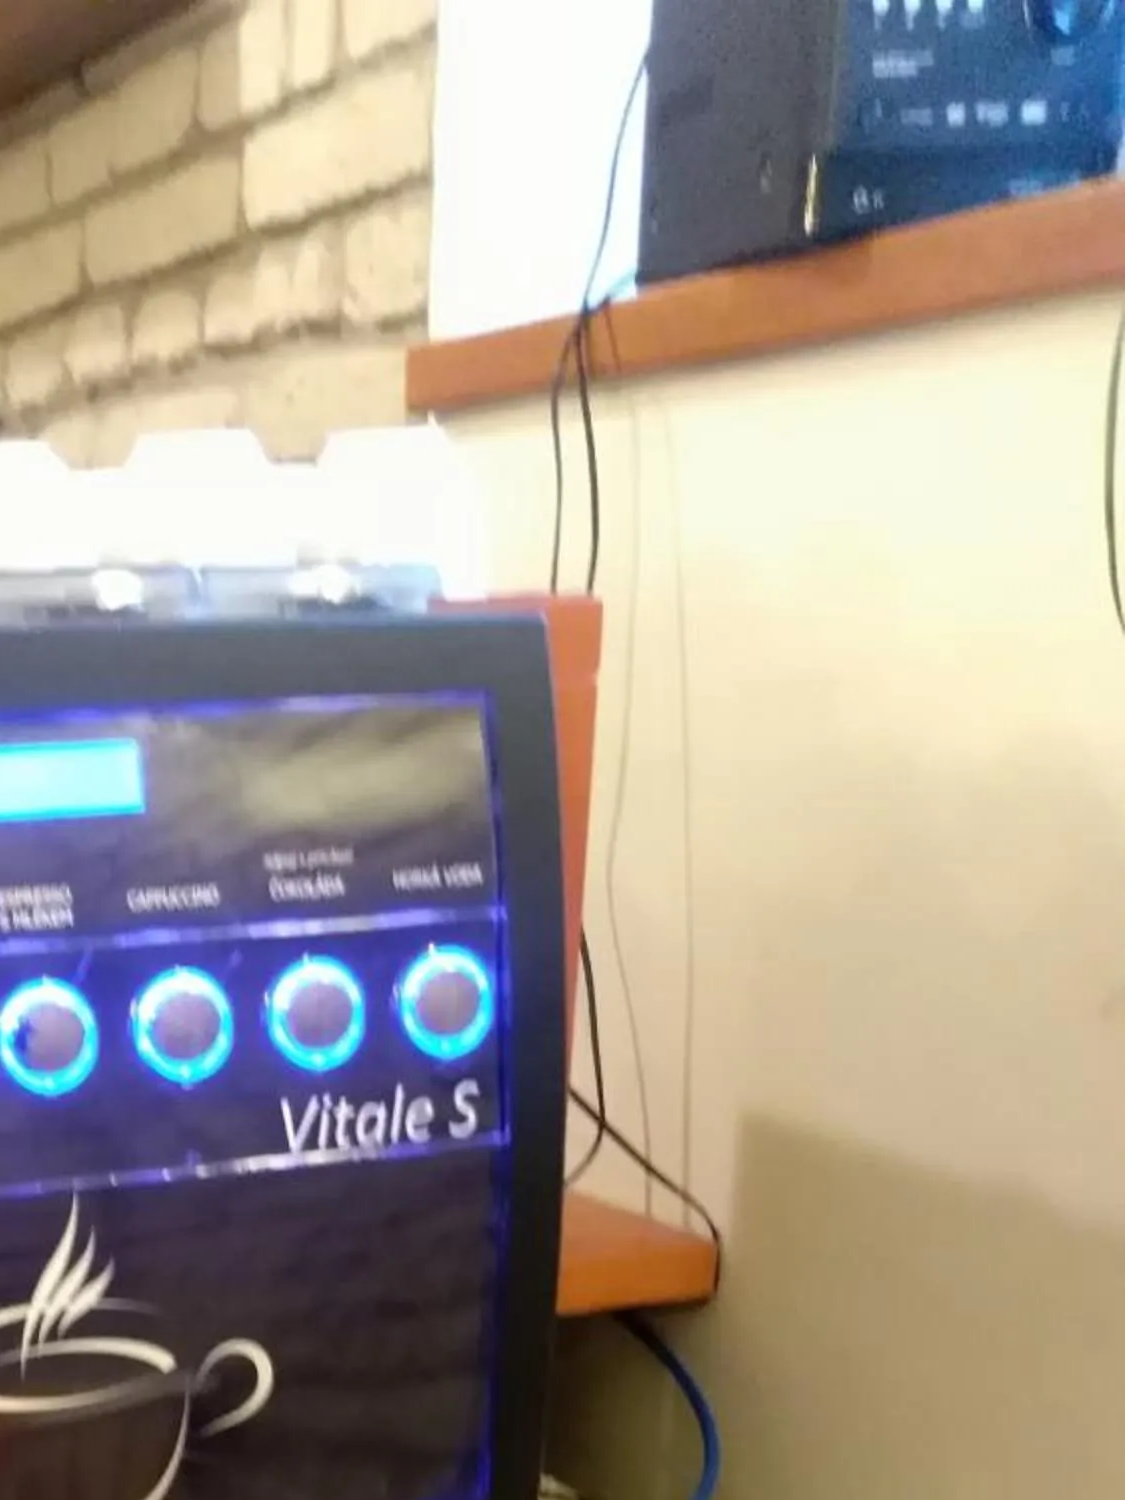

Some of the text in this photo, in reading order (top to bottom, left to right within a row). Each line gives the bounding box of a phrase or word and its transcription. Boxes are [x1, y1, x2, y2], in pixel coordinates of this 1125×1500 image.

[126, 881, 221, 913] CAPPUCCINO
[280, 1077, 481, 1152] Vitale S
